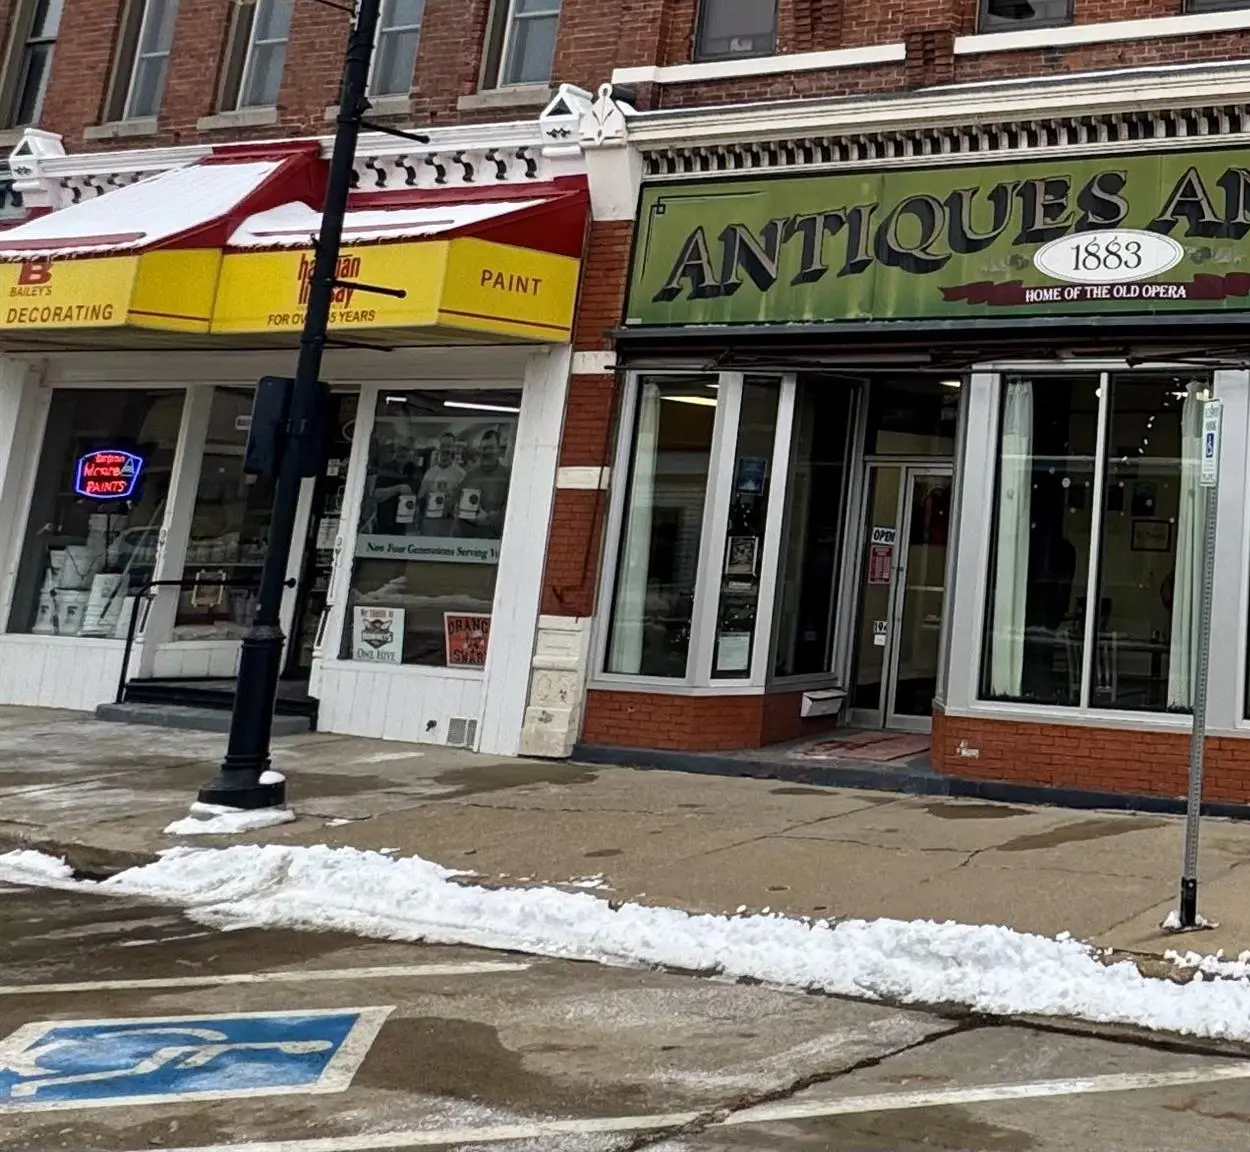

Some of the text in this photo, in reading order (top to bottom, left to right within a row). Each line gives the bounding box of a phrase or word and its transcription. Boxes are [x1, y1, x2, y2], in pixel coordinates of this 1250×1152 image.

[654, 169, 1131, 302] ANTIQUES
[1071, 236, 1143, 271] 1883
[9, 285, 53, 298] BAILEY'S
[480, 268, 543, 297] PAINT
[1025, 284, 1187, 303] HOME OF THE OLD OPERA
[6, 303, 114, 324] DECORATING
[267, 313, 290, 326] FOR
[339, 309, 376, 323] YEARS
[86, 480, 128, 493] PAINTS
[873, 529, 896, 543] OPEN
